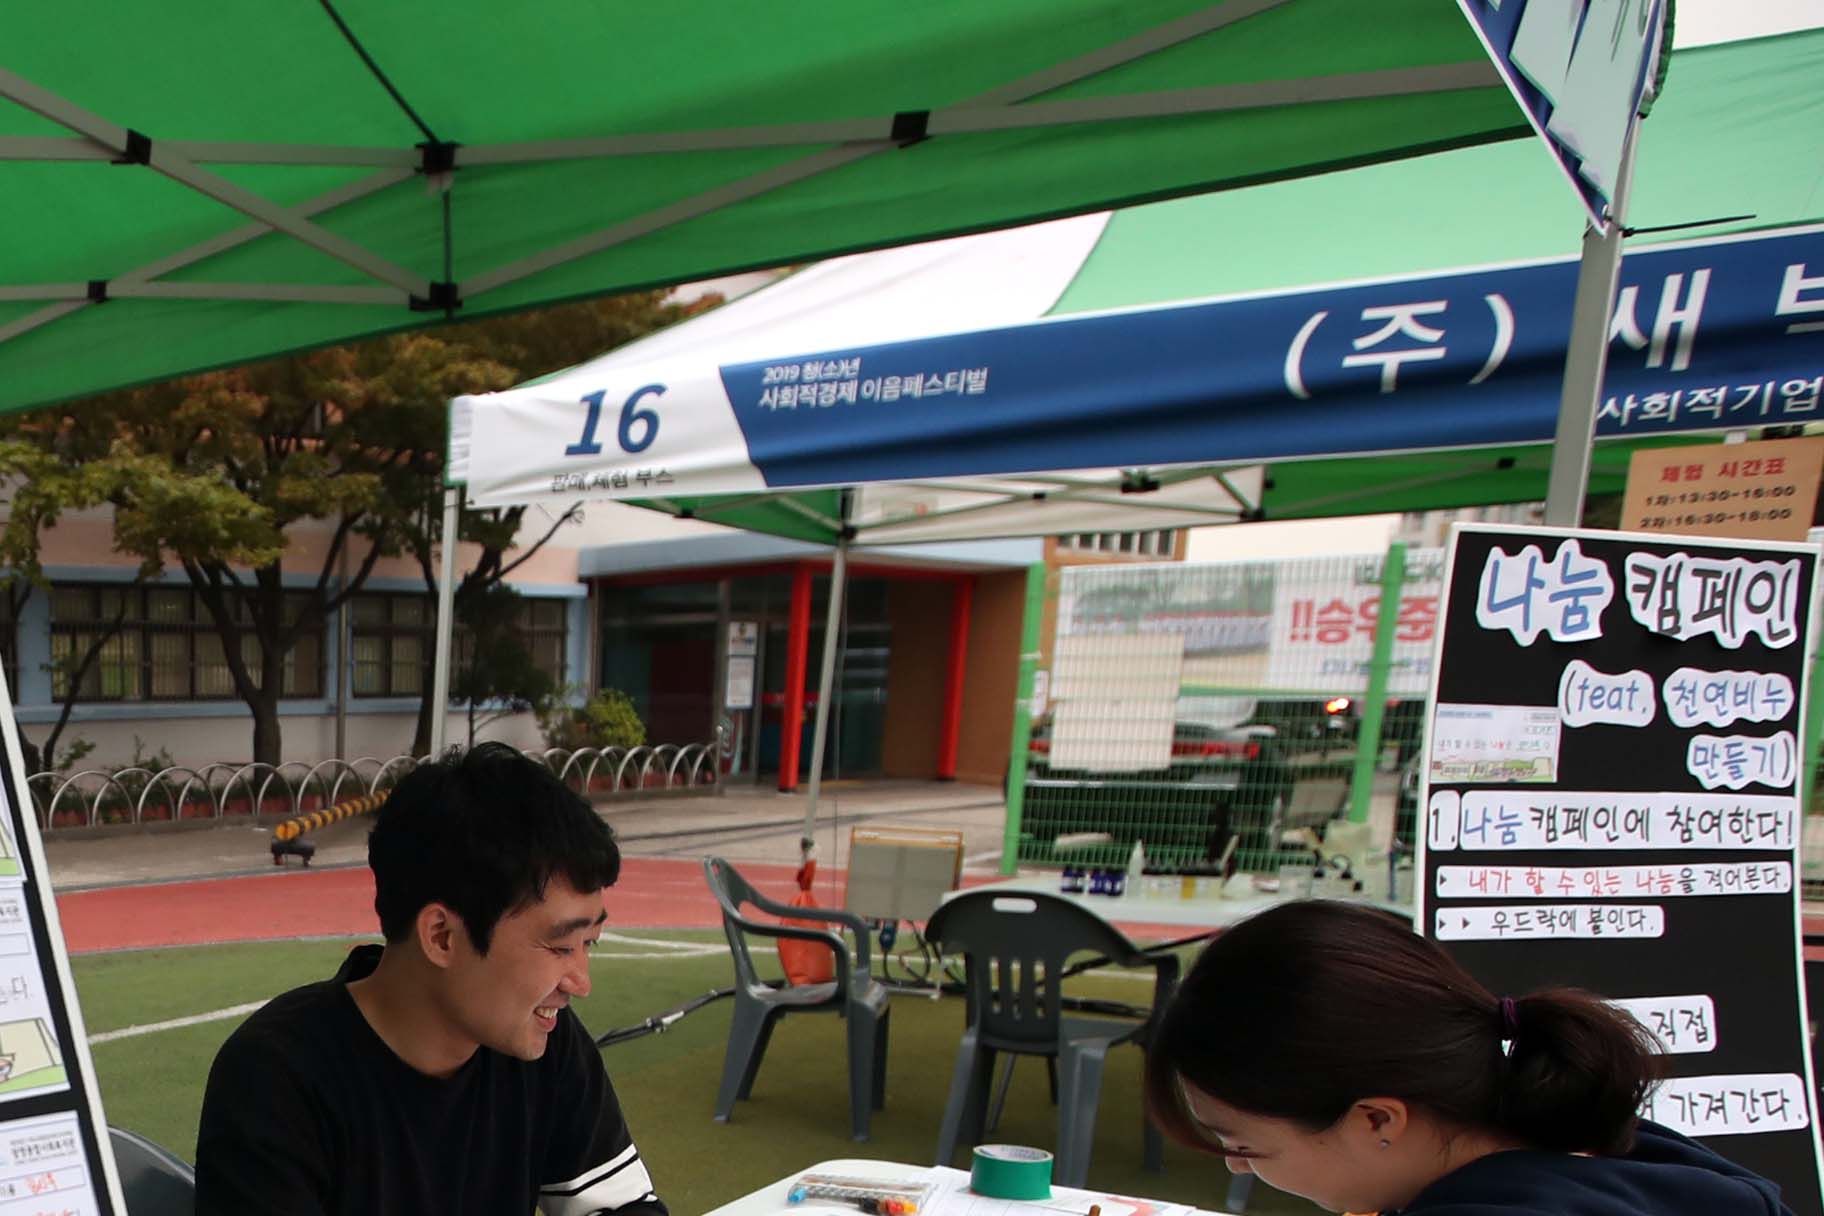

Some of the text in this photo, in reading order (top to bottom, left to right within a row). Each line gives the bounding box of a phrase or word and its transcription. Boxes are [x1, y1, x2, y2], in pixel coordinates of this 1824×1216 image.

[759, 368, 988, 410] 사회적경제 이음페스티벌
[762, 357, 861, 383] 2019 청(소)년
[565, 383, 668, 457] 16
[1597, 376, 1824, 427] 사회적기업
[635, 467, 675, 487] 부스
[1718, 457, 1787, 478] 시간표
[1488, 545, 1794, 638] 나눔 캠페인
[1671, 680, 1788, 721] 천연비누
[1692, 737, 1791, 783] 만들기)
[1465, 806, 1523, 847] 나눔
[1529, 805, 1650, 845] 캠페인에
[1667, 804, 1794, 845] 참여한다!
[1467, 867, 1788, 895] 내가 할 수 있는 나눔을 적어본다.
[1490, 908, 1656, 935] 우드락에 붙인다.
[1651, 1007, 1708, 1045] 직접
[1670, 1088, 1803, 1126] 가져간다.
